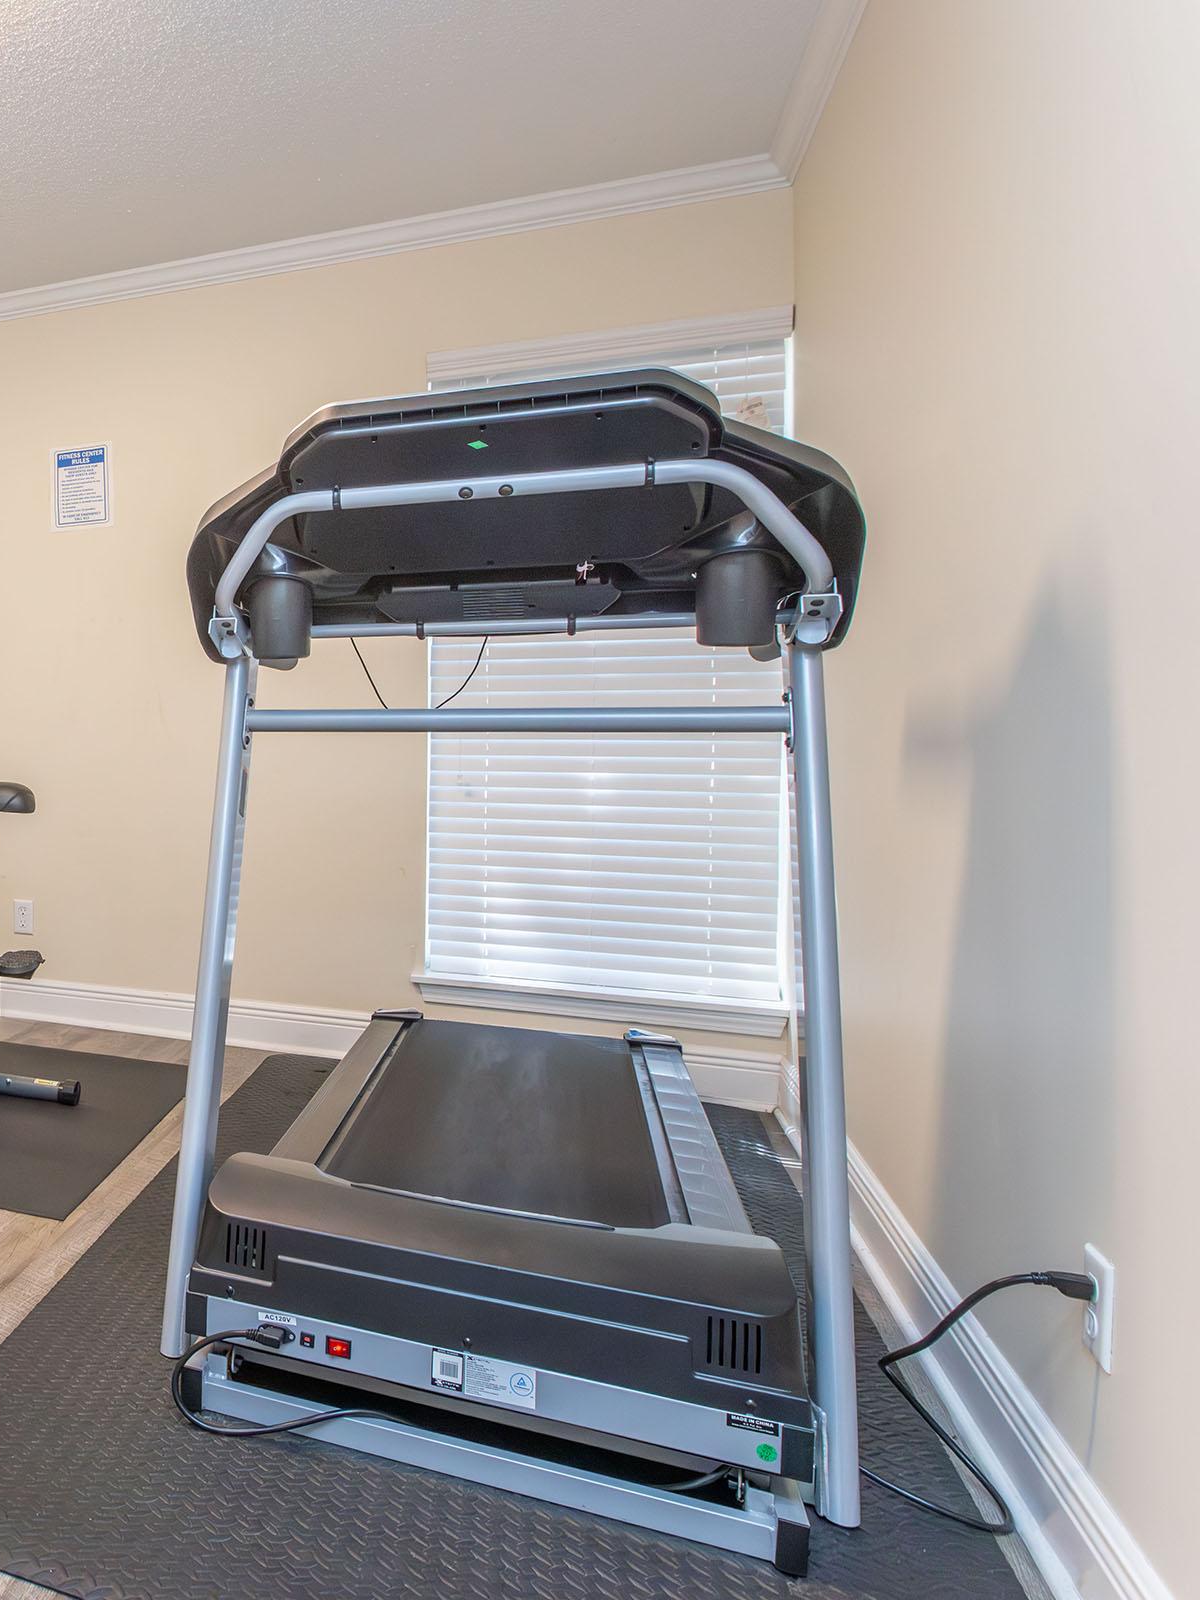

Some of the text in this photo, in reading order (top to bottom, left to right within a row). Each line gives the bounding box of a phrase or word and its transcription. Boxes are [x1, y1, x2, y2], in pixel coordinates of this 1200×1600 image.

[81, 449, 103, 457] CENTER
[264, 1314, 291, 1323] AC120V
[755, 1420, 774, 1428] CHINA
